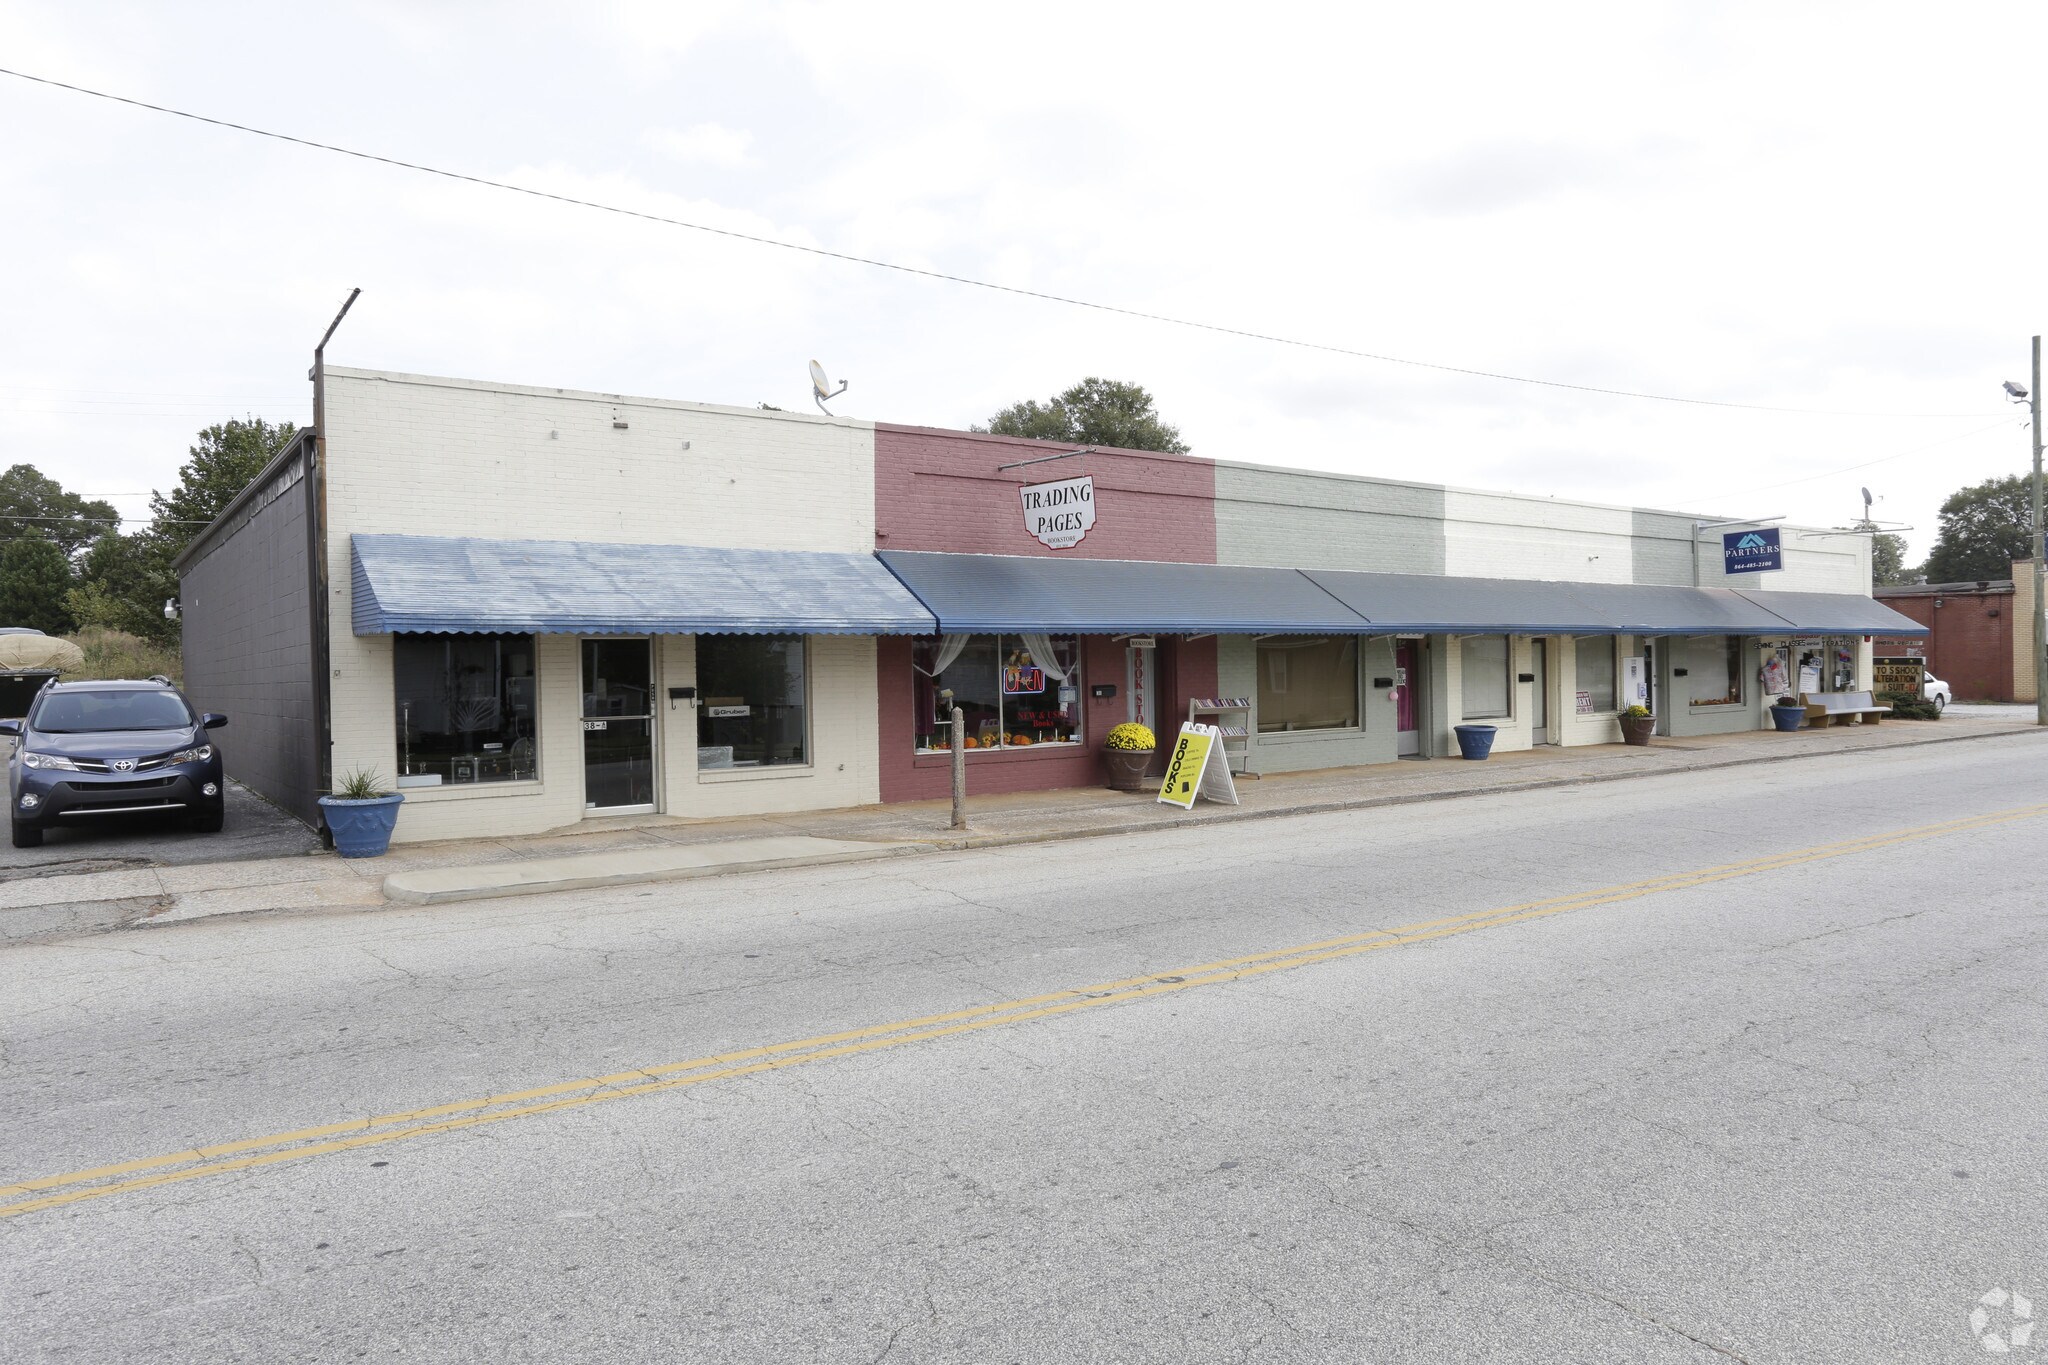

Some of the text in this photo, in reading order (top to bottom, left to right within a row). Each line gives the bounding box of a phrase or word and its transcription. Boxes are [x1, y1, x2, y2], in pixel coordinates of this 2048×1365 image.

[1024, 484, 1091, 510] TRADING
[1037, 512, 1082, 534] PAGES
[1047, 536, 1076, 544] BOOKSTORE
[1725, 545, 1780, 558] PARTNERS
[1780, 640, 1806, 648] CLASSES
[1135, 648, 1143, 690] BOOK
[1876, 667, 1887, 675] TO
[1888, 684, 1905, 692] SUIT
[1018, 711, 1036, 720] NEW
[584, 721, 606, 730] 38-A
[1033, 720, 1054, 728] Books
[1165, 738, 1188, 794] BOOKS
